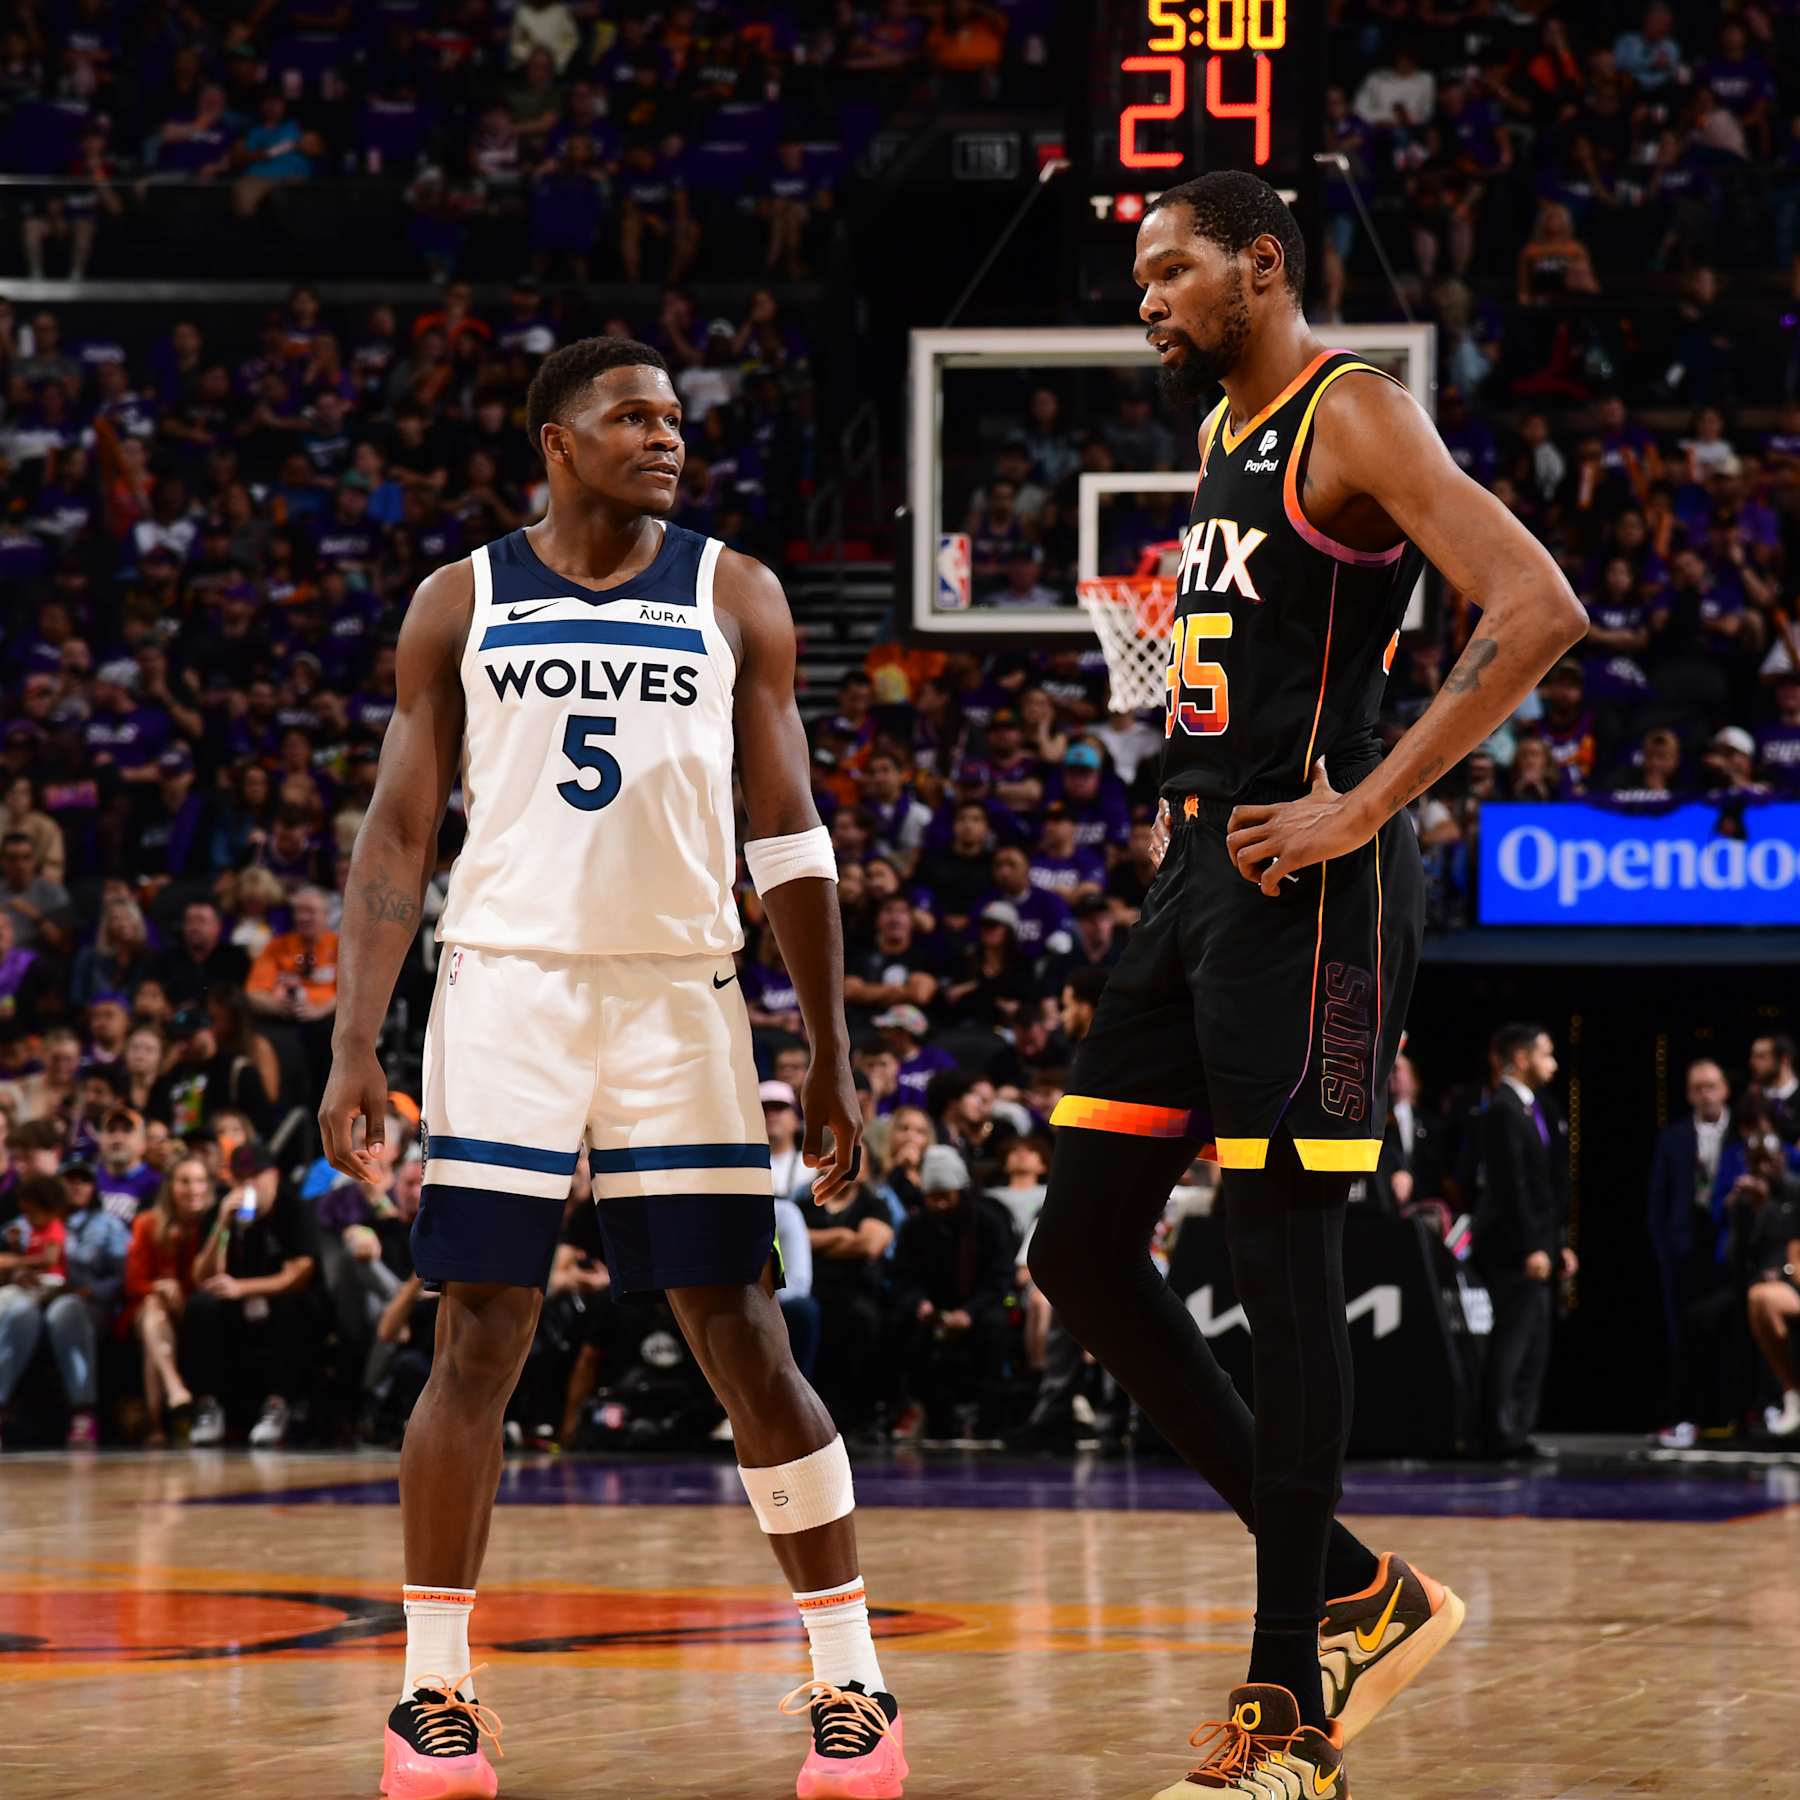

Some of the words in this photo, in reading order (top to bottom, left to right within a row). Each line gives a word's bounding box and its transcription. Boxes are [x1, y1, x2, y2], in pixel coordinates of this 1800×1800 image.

[1148, 0, 1286, 51] 5:00
[1120, 56, 1272, 168] 24
[1243, 459, 1280, 473] PayPal
[485, 659, 699, 706] WOLVES
[556, 714, 622, 812] 5
[1497, 824, 1800, 907] Opendo
[772, 1490, 789, 1507] 5
